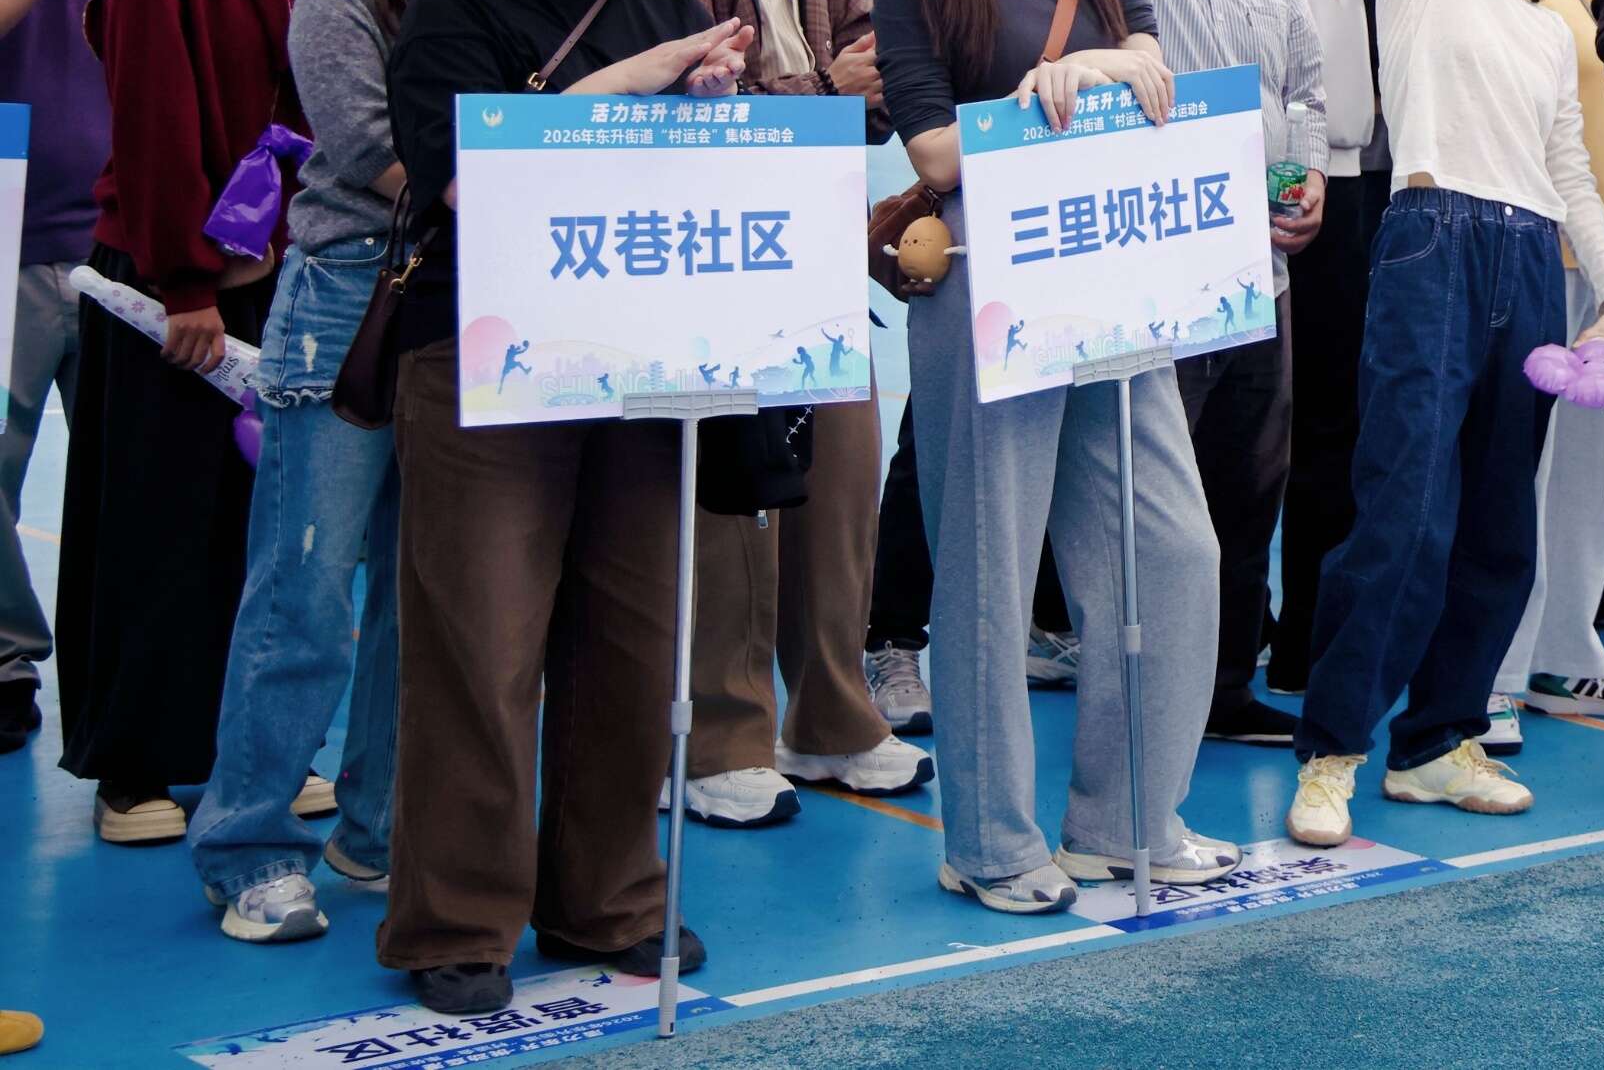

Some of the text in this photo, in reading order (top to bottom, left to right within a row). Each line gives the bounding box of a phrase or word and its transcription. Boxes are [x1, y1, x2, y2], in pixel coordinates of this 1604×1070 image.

[590, 102, 751, 124] 活力东升·悦动空港
[549, 209, 793, 280] 双巷社区
[1010, 172, 1235, 265] 三里坝社区
[314, 996, 609, 1064] 普贤社区
